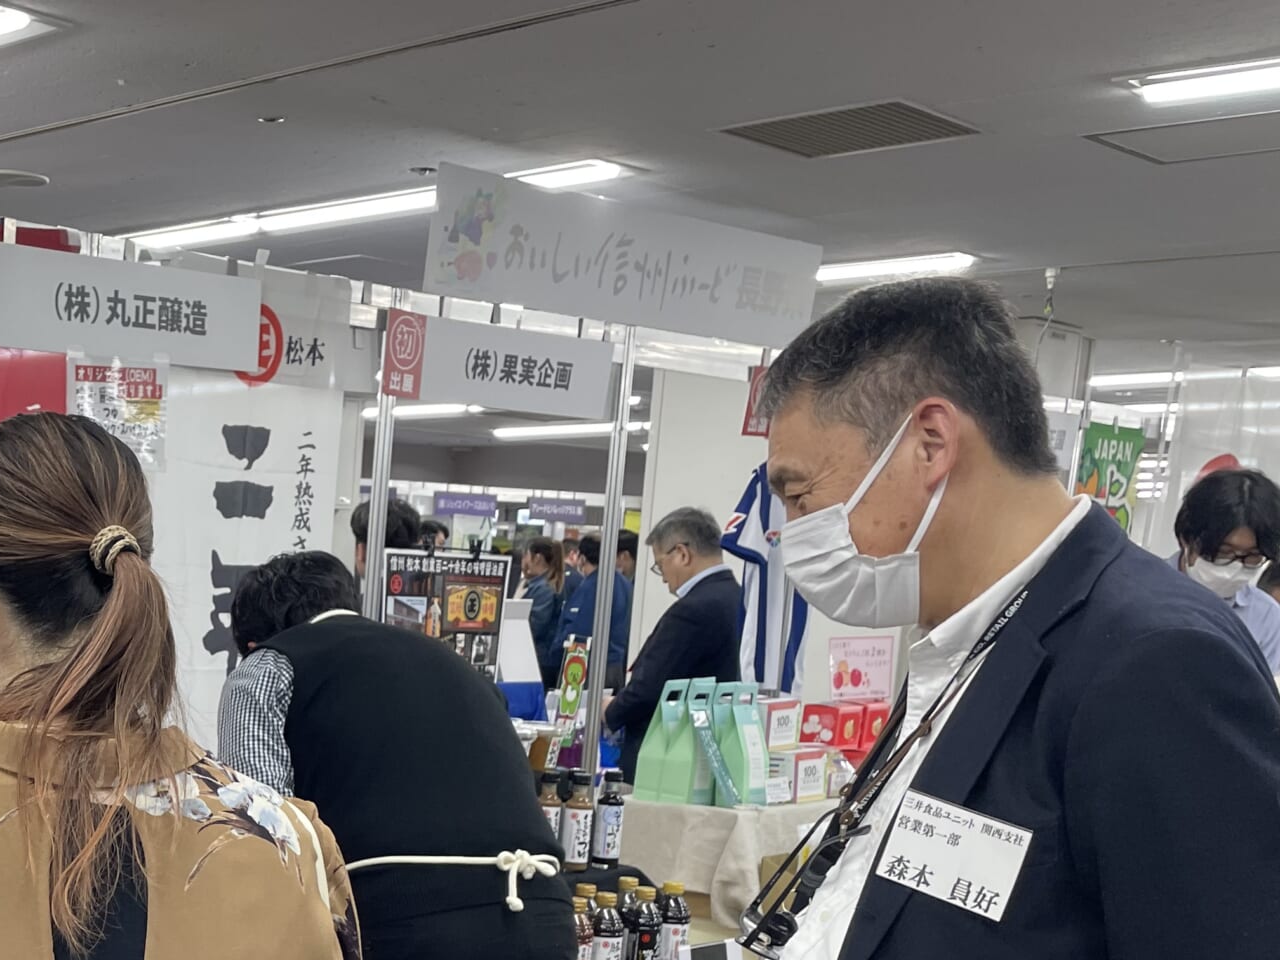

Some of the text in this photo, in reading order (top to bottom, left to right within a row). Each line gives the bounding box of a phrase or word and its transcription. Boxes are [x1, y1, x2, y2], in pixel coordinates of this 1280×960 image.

[54, 281, 208, 337] (株)丸正醸造
[285, 335, 326, 367] 松本
[388, 371, 415, 394] 出展
[464, 346, 574, 392] (株)果実企画
[1094, 438, 1134, 462] JAPAN
[903, 797, 975, 829] 三井食品ユニット
[897, 815, 963, 847] 営業第一部
[884, 855, 935, 888] 森本
